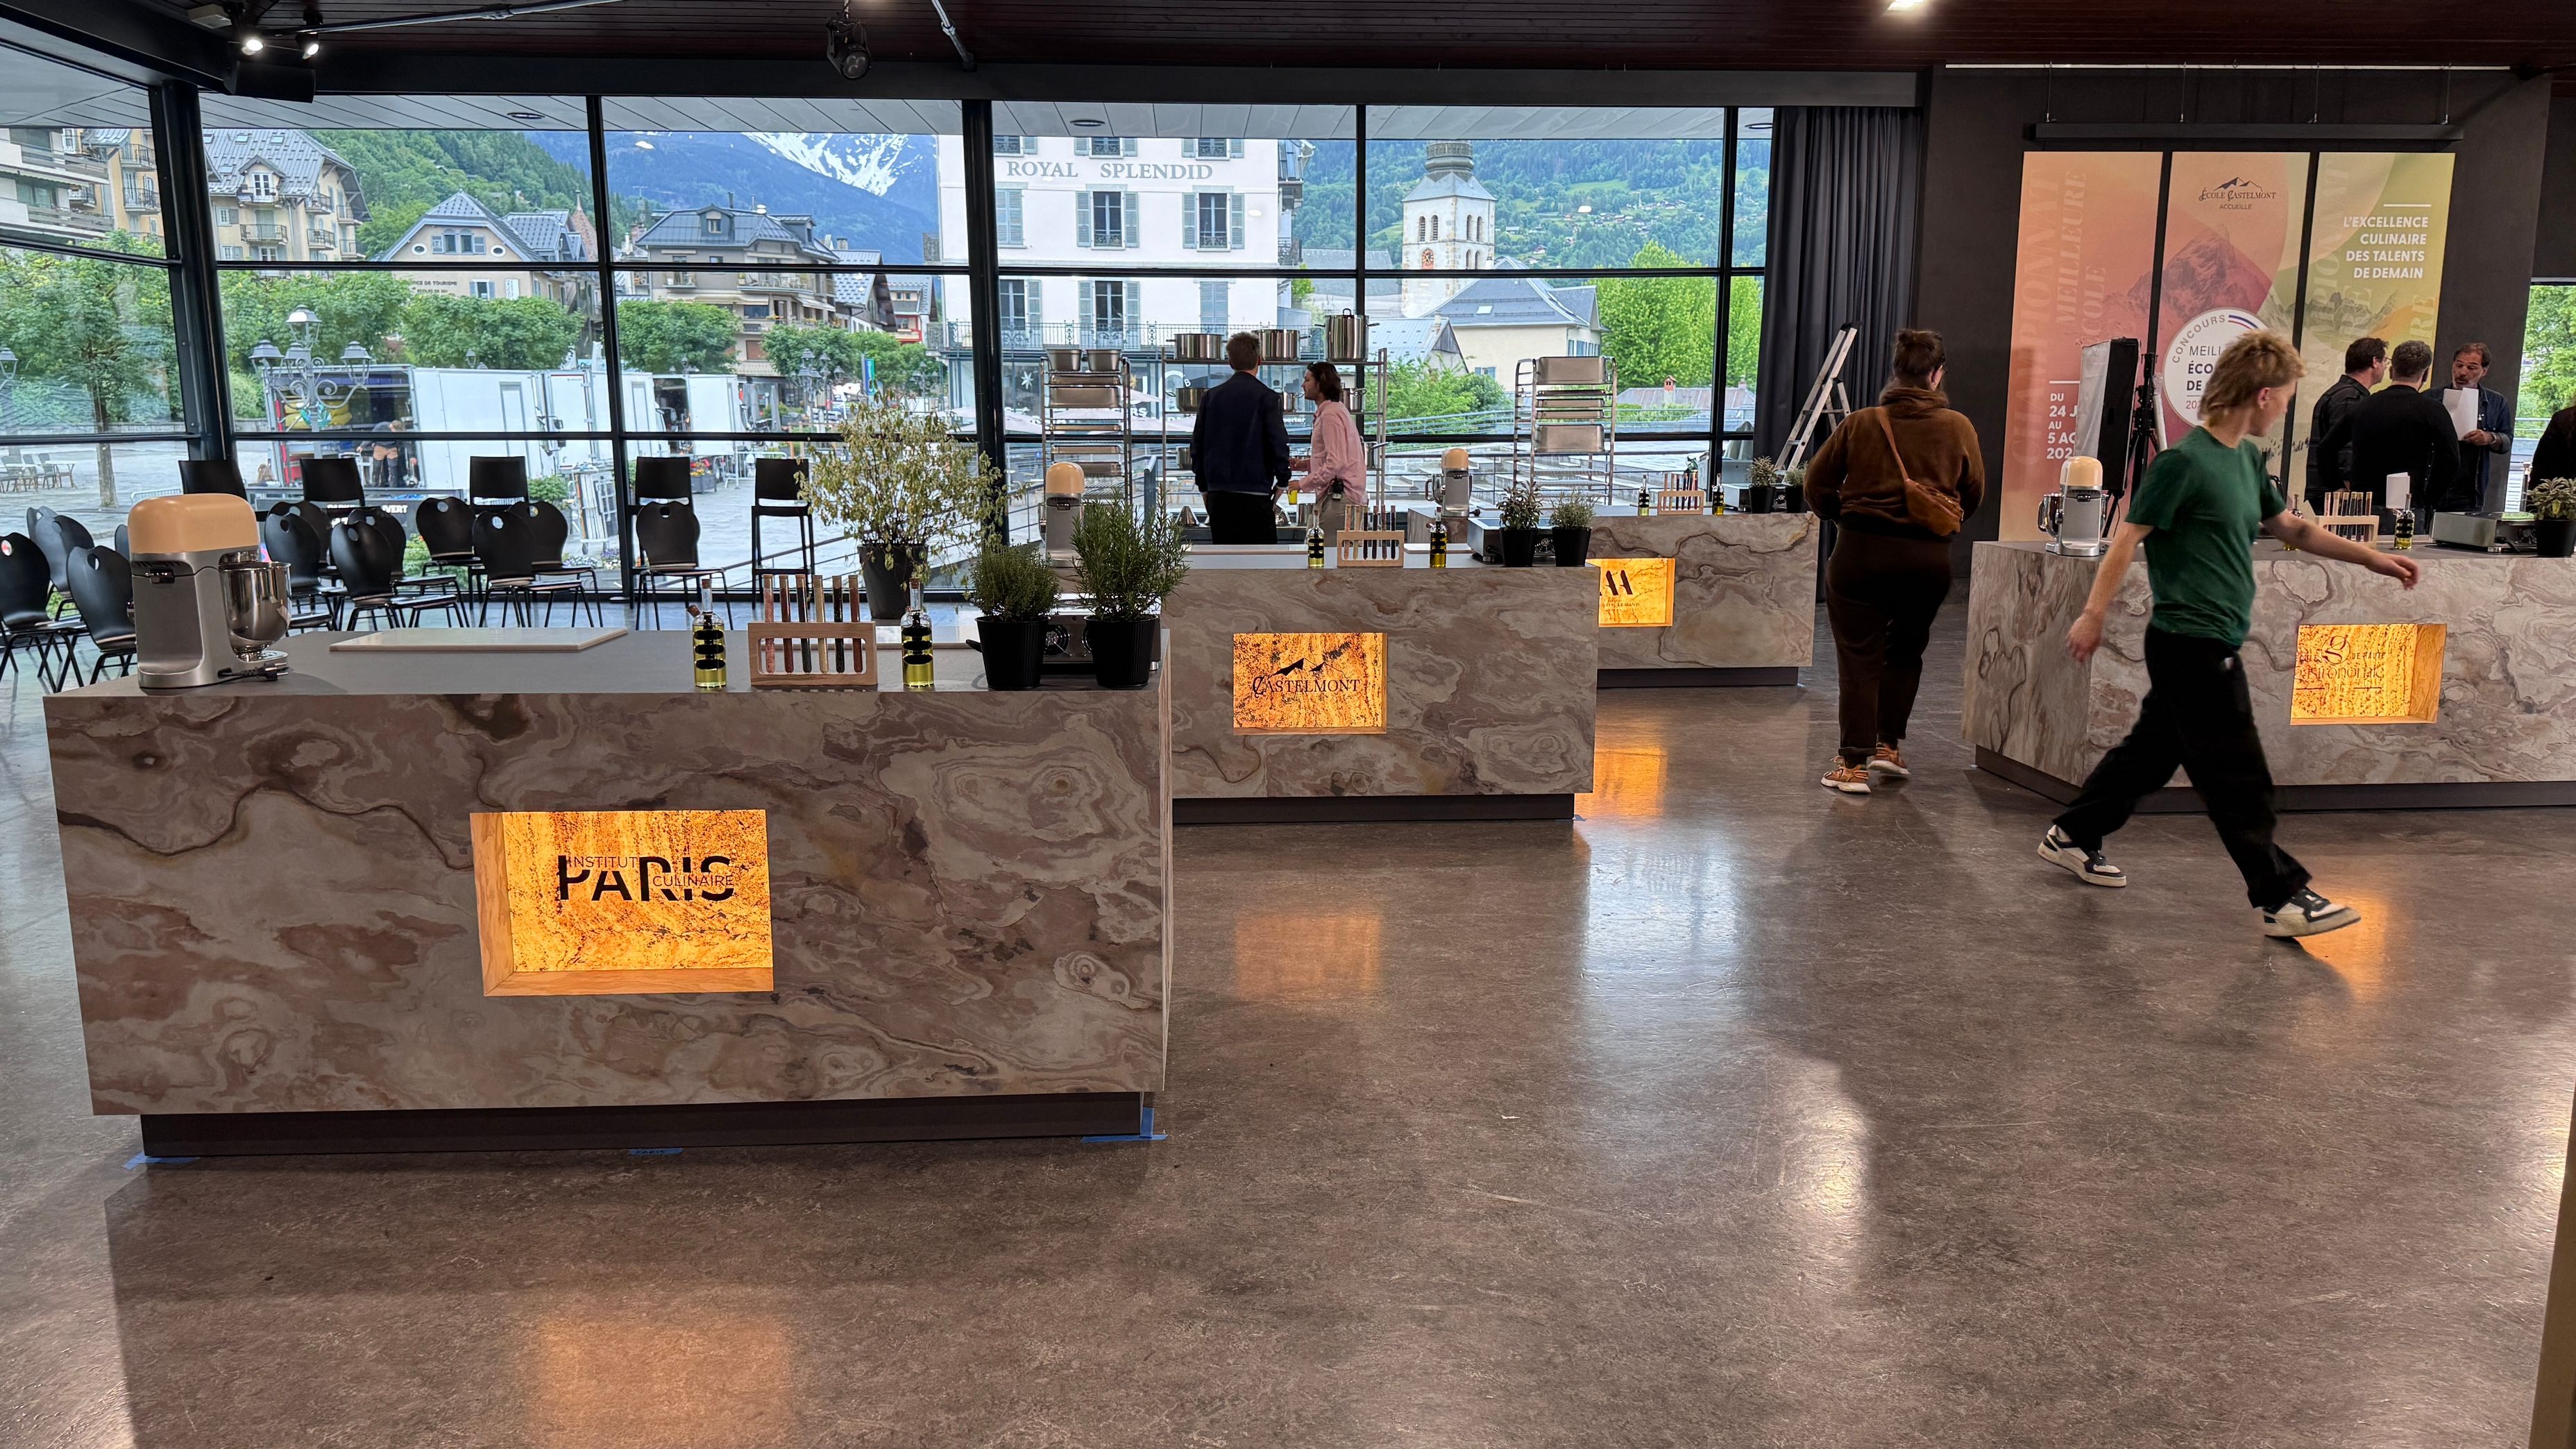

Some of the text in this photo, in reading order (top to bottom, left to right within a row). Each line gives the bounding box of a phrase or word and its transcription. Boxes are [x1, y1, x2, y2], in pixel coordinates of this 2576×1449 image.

[1007, 161, 1213, 180] ROYAL SPLENDID
[2198, 187, 2276, 201] ÉCOLE CASTELMONT
[2343, 217, 2428, 228] L'EXCELLENCE
[2360, 233, 2427, 244] CULINAIRE
[2055, 171, 2087, 325] MEILLEURE
[2346, 251, 2425, 262] DES TALENTS
[2353, 267, 2423, 278] DE DEMAIN
[2080, 264, 2106, 344] COLE
[2172, 315, 2226, 364] CONCOURS
[2189, 346, 2221, 356] MEILL
[2188, 361, 2214, 374] ÉCO
[2187, 380, 2202, 391] DE
[2050, 393, 2065, 402] DU
[2049, 405, 2067, 417] 24
[2048, 421, 2062, 430] AU
[2047, 432, 2056, 444] 5
[2047, 447, 2073, 459] 202
[382, 505, 408, 513] VERT
[1253, 675, 1361, 698] CASTELMONT
[566, 856, 639, 868] INSTITUT
[557, 854, 735, 902] PARIS
[652, 875, 735, 887] CULINAIRE
